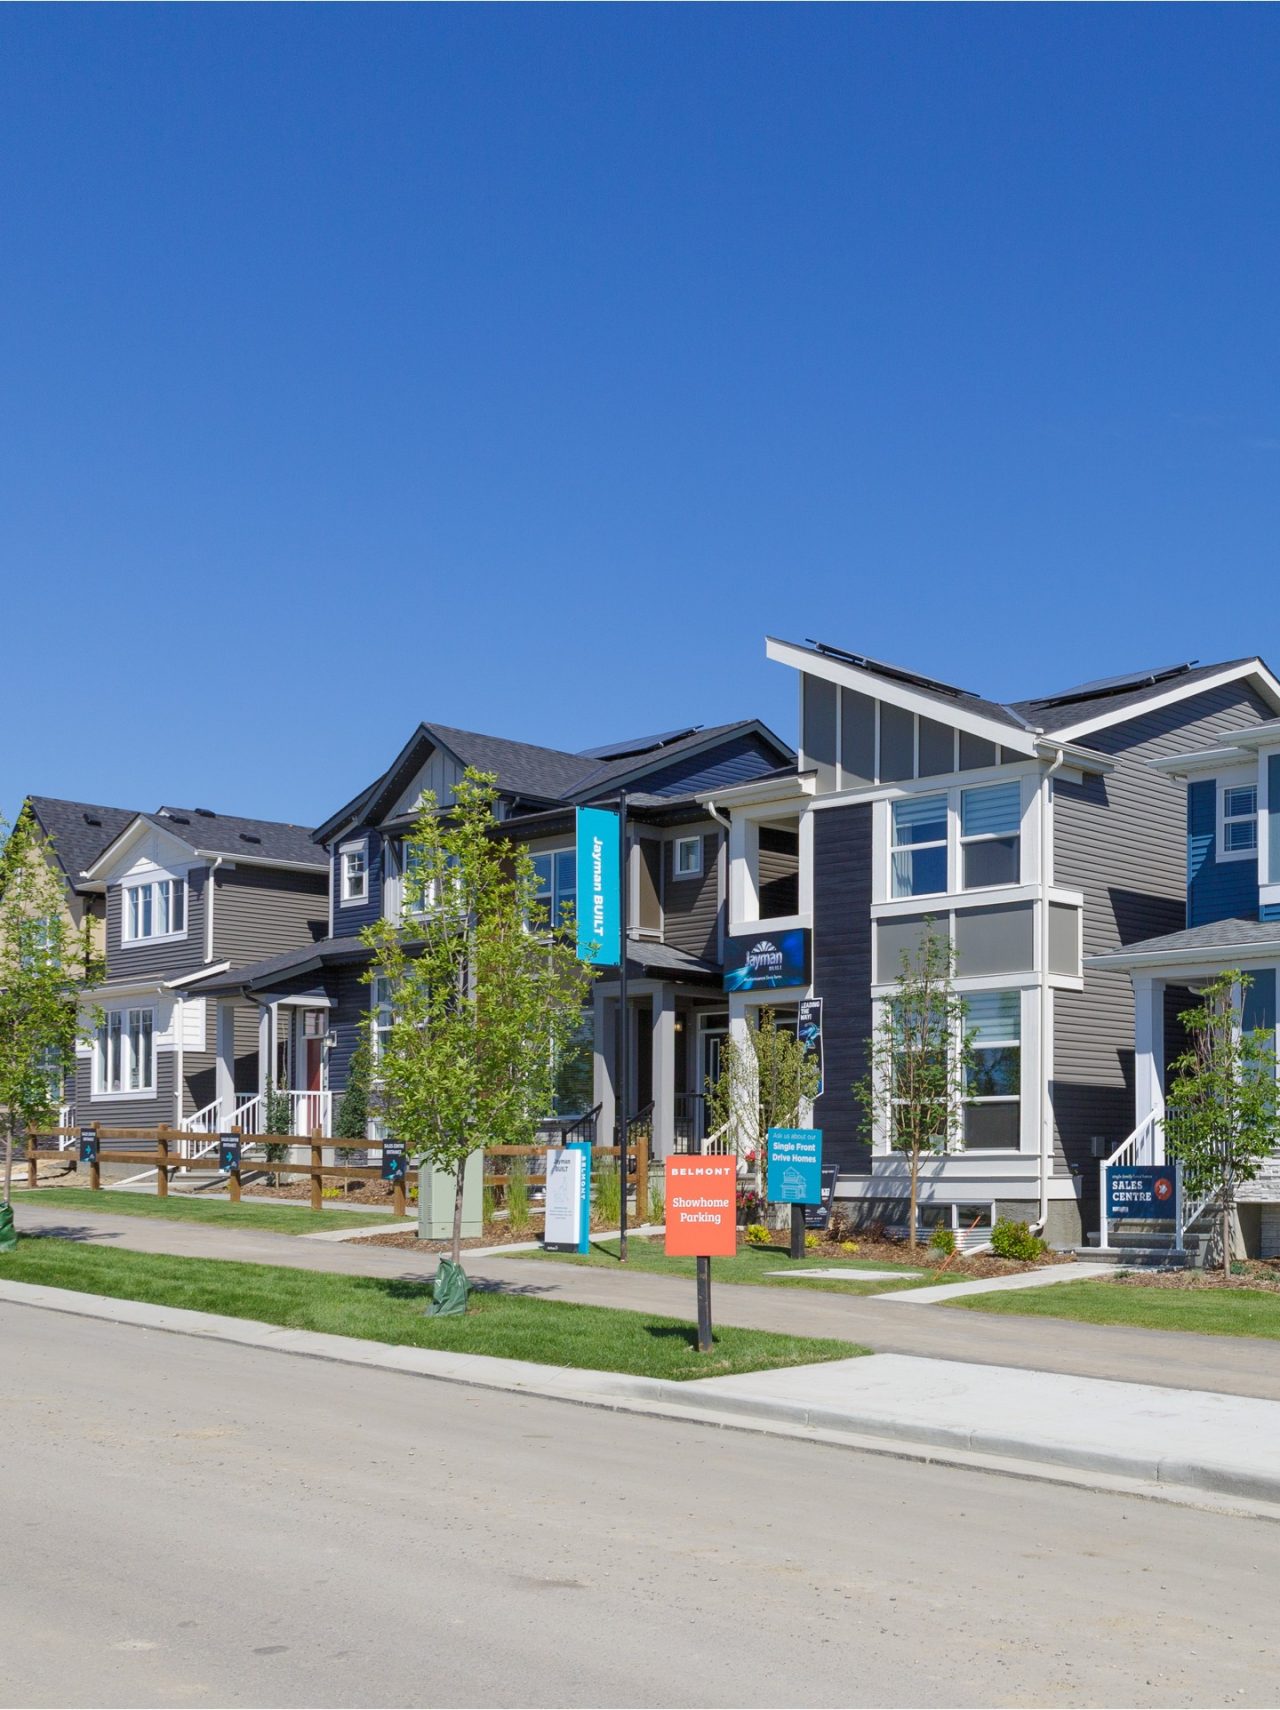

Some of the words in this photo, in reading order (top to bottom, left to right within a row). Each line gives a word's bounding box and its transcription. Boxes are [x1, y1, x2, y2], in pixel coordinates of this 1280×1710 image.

[591, 836, 603, 892] Jayman
[593, 894, 604, 937] BUILT
[744, 951, 783, 971] Jayman
[773, 1142, 795, 1152] Single
[796, 1143, 816, 1152] Front
[772, 1153, 791, 1162] Drive
[791, 1154, 817, 1163] Homes
[671, 1168, 731, 1176] BELMONT
[1112, 1180, 1143, 1190] SALES
[1112, 1192, 1152, 1201] CENTRE
[672, 1197, 730, 1208] Showhome
[680, 1212, 721, 1225] Parking
